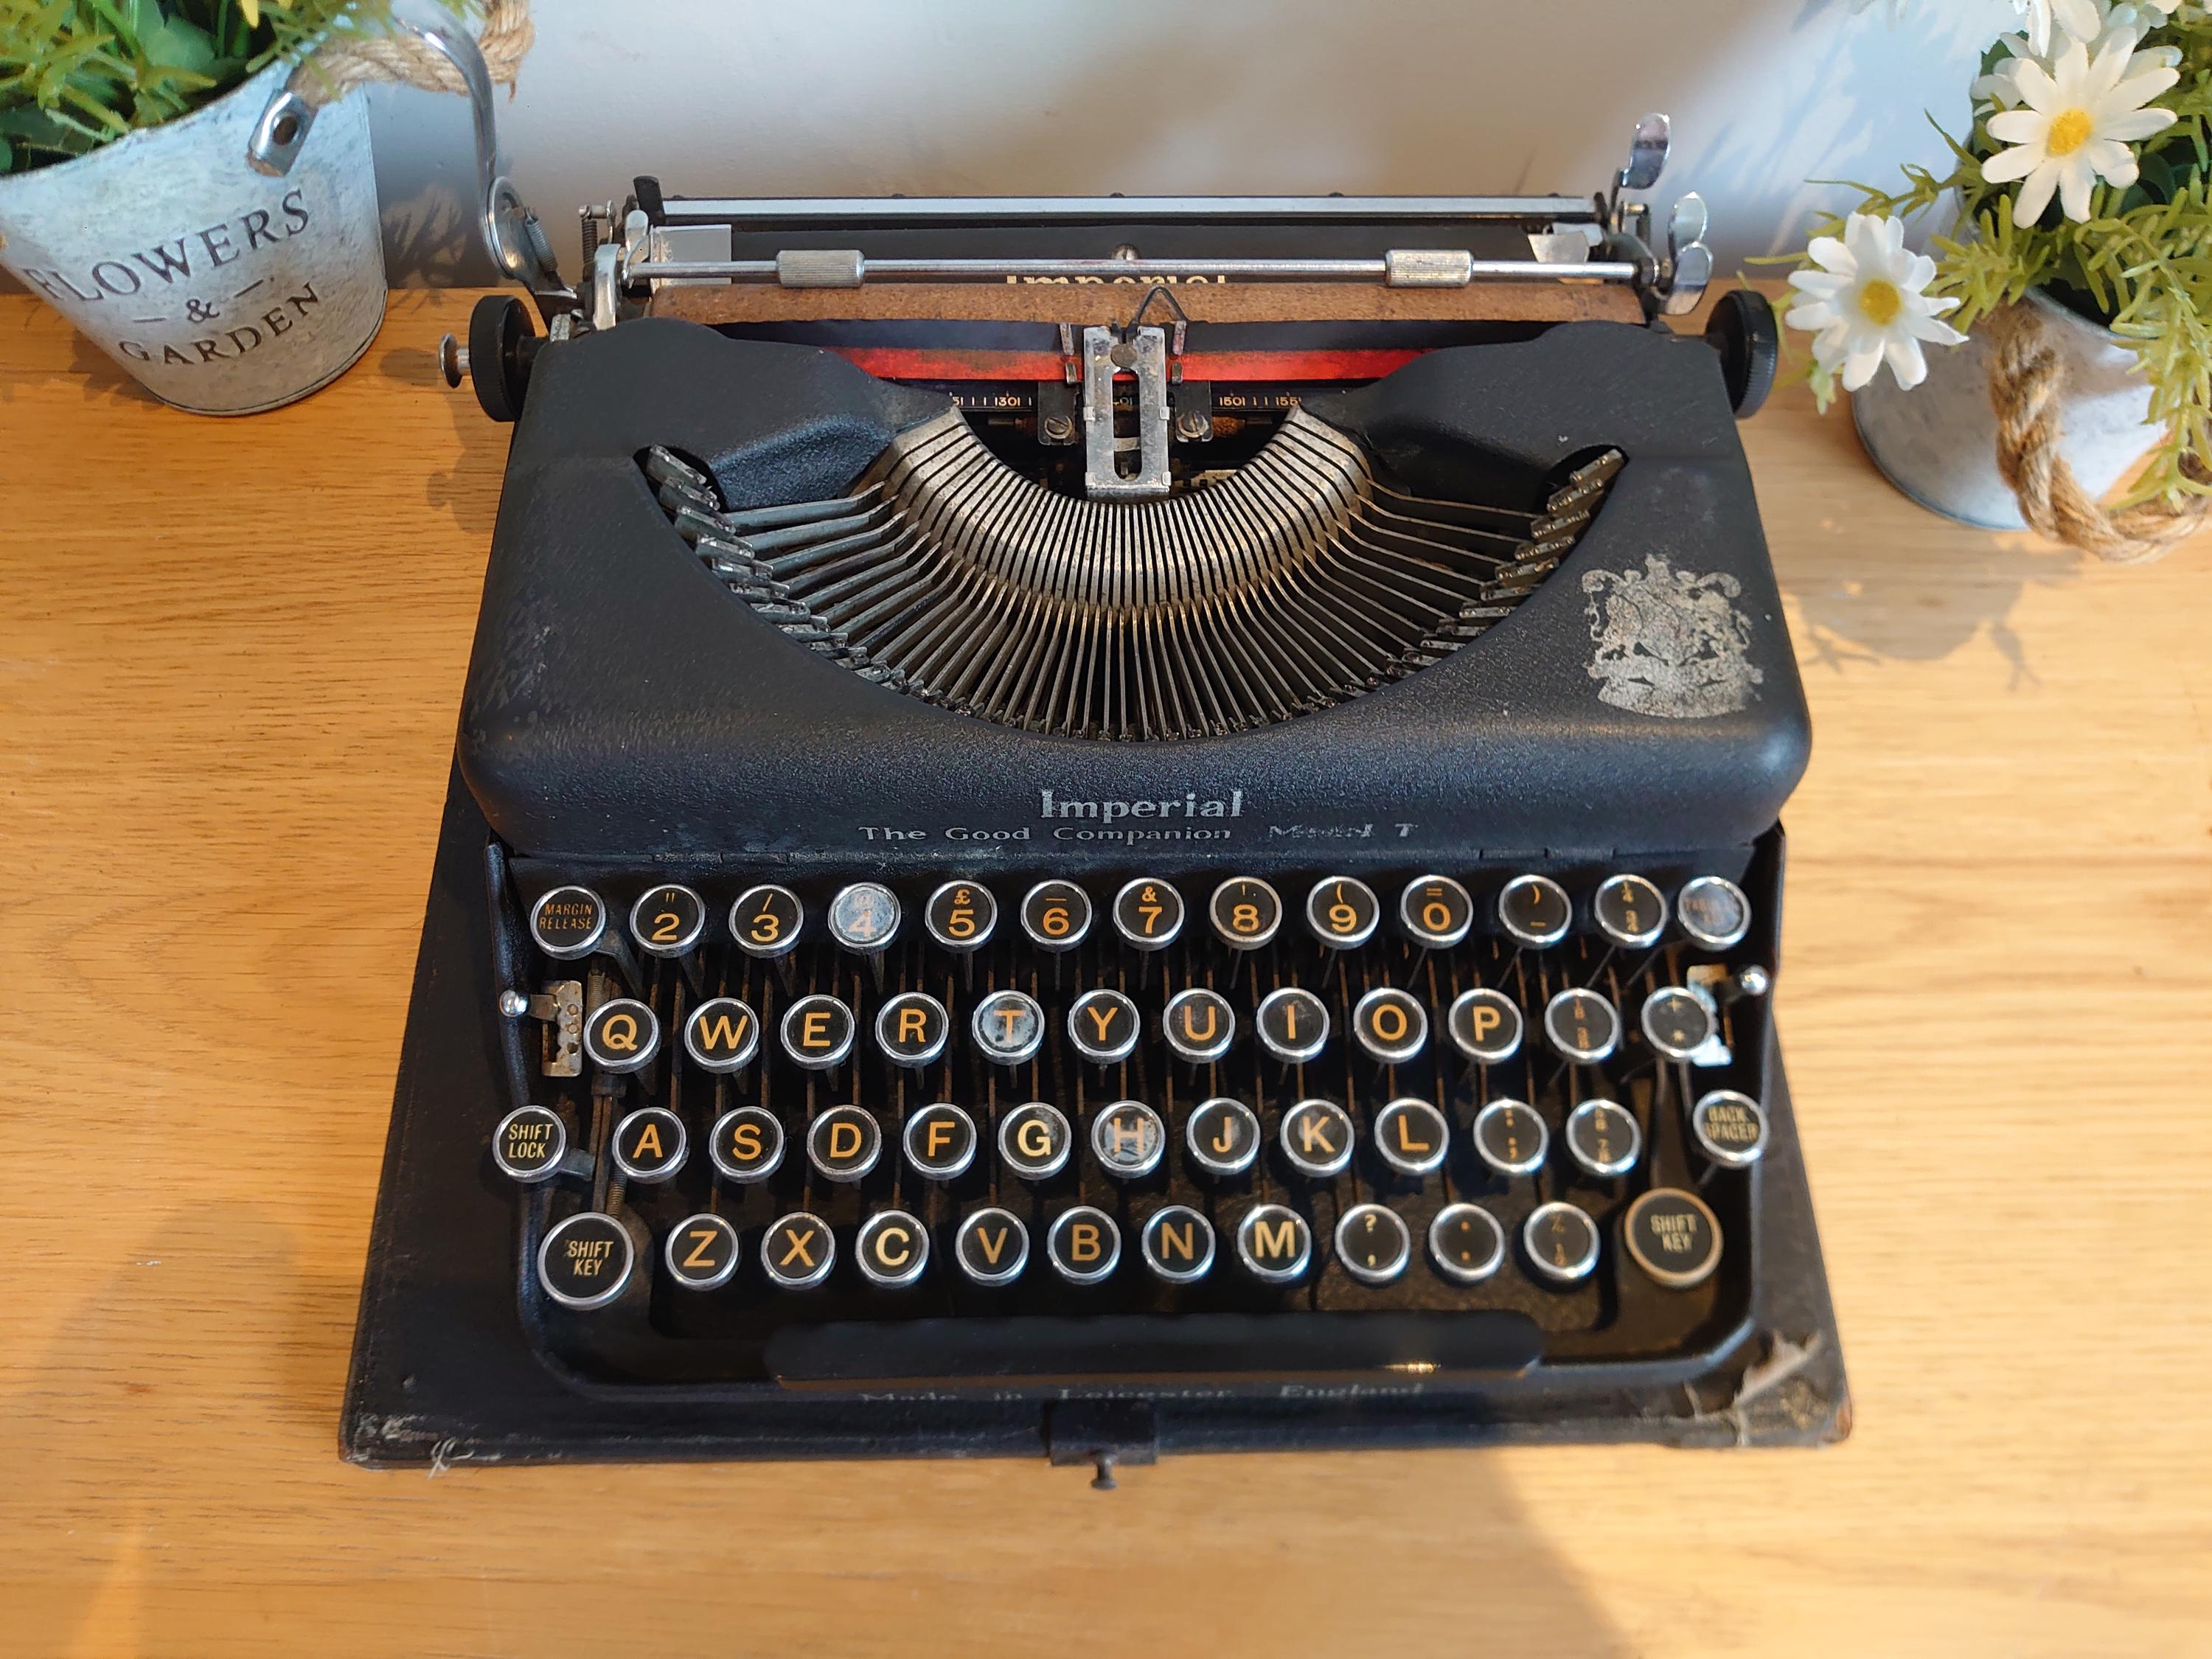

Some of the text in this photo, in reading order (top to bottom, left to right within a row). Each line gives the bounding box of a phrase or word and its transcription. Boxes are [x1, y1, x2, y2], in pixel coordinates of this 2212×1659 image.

[23, 189, 309, 302] FLOWERS
[118, 281, 319, 366] GARDEN
[1040, 789, 1244, 824] Imperial
[858, 826, 927, 841] The
[945, 827, 1031, 841] Good
[1053, 826, 1231, 846] Companion
[539, 917, 591, 930] RELEASE
[545, 903, 592, 916] MARGIN
[651, 913, 678, 941] 2
[849, 909, 877, 938] 4
[948, 909, 975, 937] 5
[1043, 907, 1070, 936] 6
[1138, 906, 1163, 934] 7
[1232, 904, 1259, 932] 8
[1329, 903, 1357, 933] 9
[751, 914, 779, 942] 3
[602, 1014, 638, 1051] Q
[699, 1015, 748, 1050] W
[803, 1012, 831, 1047] E
[899, 1008, 927, 1043] R
[993, 1009, 1024, 1045] T
[1087, 1006, 1118, 1041] Y
[1184, 1006, 1216, 1041] U
[1371, 1004, 1408, 1040] O
[1472, 1006, 1500, 1042] P
[1708, 1105, 1750, 1122] BACK
[508, 1123, 553, 1140] SHIFT
[633, 1124, 663, 1158] A
[732, 1124, 762, 1161] S
[830, 1122, 862, 1158] D
[928, 1121, 956, 1157] F
[1018, 1119, 1051, 1157] G
[1112, 1116, 1145, 1154] H
[1212, 1116, 1233, 1153] J
[1302, 1116, 1335, 1152] K
[1398, 1115, 1429, 1151] L
[508, 1141, 546, 1158] LOCK
[1161, 1222, 1194, 1260] N
[1254, 1221, 1295, 1258] M
[1650, 1214, 1697, 1234] SHIFT
[567, 1240, 613, 1258] SHIFT
[683, 1230, 717, 1267] Z
[780, 1229, 815, 1267] X
[875, 1227, 909, 1266] C
[977, 1227, 1006, 1264] V
[1072, 1224, 1101, 1261] B
[1661, 1233, 1693, 1252] KEY
[574, 1259, 602, 1276] KEY
